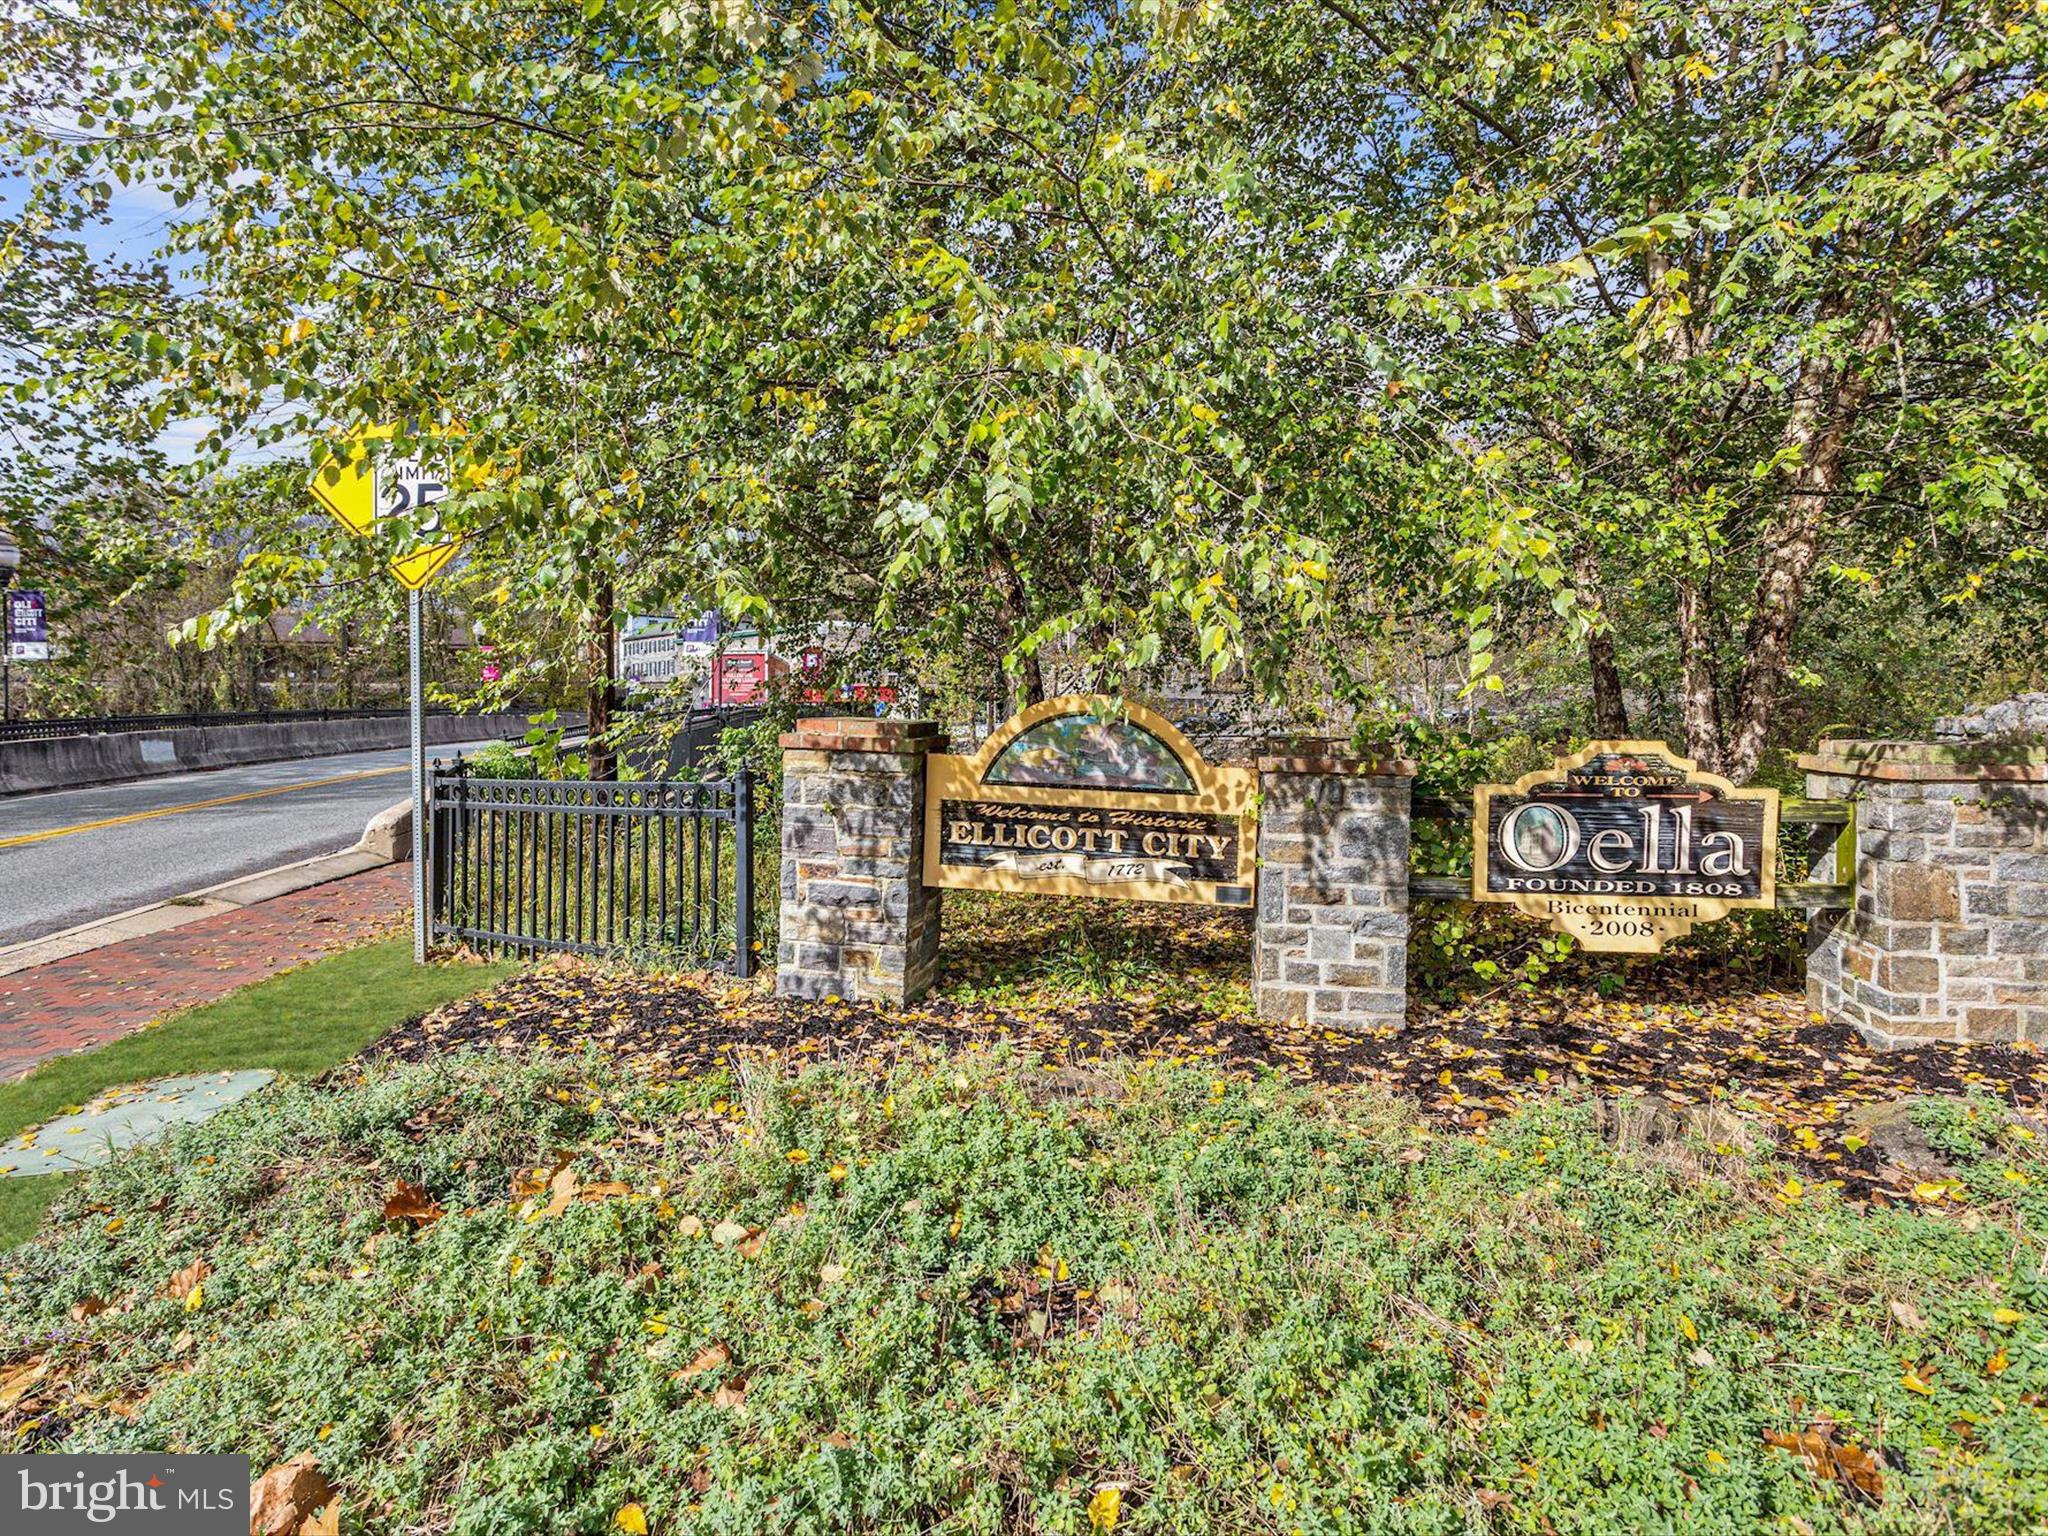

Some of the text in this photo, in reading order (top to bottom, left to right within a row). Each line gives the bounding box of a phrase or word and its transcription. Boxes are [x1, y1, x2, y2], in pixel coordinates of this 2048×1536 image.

[1571, 775, 1679, 787] WELCOME
[1610, 786, 1640, 798] TO
[974, 803, 1208, 831] Welcome to Historic
[947, 820, 1233, 860] ELLICOTT CITY
[1497, 801, 1751, 878] Oella
[1034, 857, 1146, 877] est. 1772
[1505, 877, 1743, 897] FOUNDED 1808
[1547, 899, 1699, 918] Bicentennial
